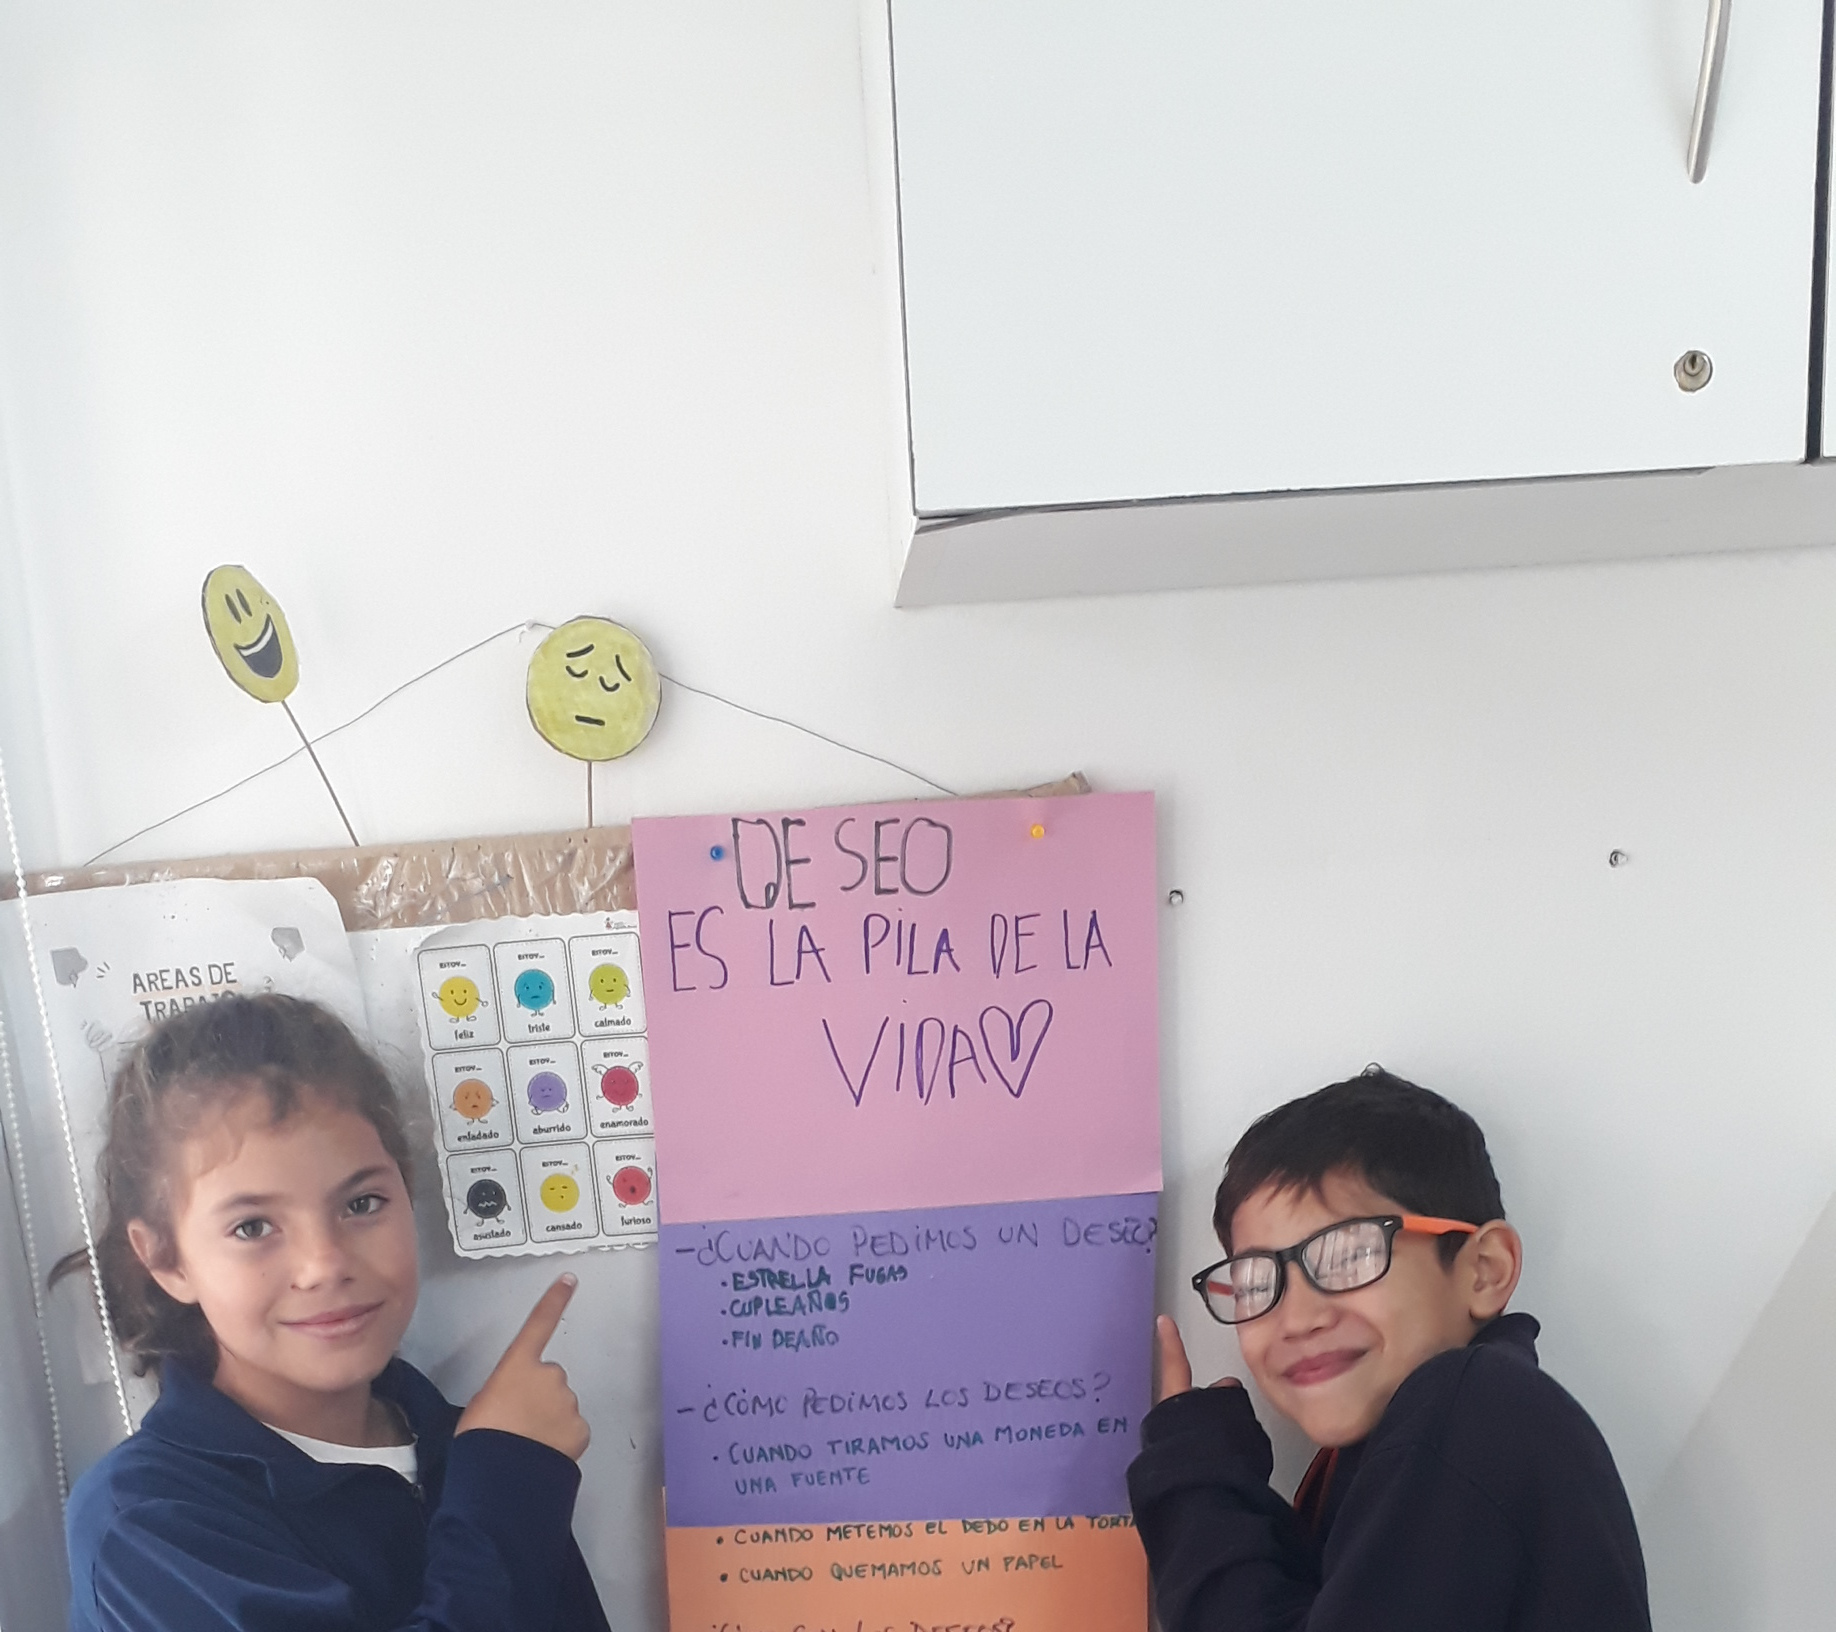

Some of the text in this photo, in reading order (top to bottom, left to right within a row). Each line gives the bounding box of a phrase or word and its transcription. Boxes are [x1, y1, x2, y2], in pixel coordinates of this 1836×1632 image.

[668, 905, 1112, 992] ES LA PILA DE LA
[132, 962, 237, 994] AREAS DE
[528, 1021, 551, 1034] triste
[594, 1015, 632, 1028] calmado
[454, 1028, 475, 1041] feliz
[532, 1122, 571, 1135] aburrido
[600, 1117, 649, 1129] enamorado
[457, 1130, 499, 1143] enfadado
[545, 1220, 583, 1233] cansado
[621, 1215, 652, 1226] furioso
[473, 1227, 511, 1240] asustado
[998, 1221, 1038, 1248] UN
[732, 1265, 831, 1291] ESTRELLA
[729, 1289, 850, 1317] CUPLEAÑOS
[732, 1331, 762, 1350] FIN
[925, 1388, 969, 1408] LOS
[729, 1416, 1127, 1465] CUANDO TIRAMOS UNA MONEDA EN
[735, 1467, 870, 1495] UNA FUENTE
[734, 1527, 813, 1545] CUANDO
[826, 1522, 913, 1542] METEMOS
[961, 1519, 1009, 1535] DEDO
[1018, 1517, 1045, 1532] EN
[1056, 1516, 1074, 1530] LA
[740, 1554, 1063, 1583] CUANDO QUEMAMOS UN PAPEL
